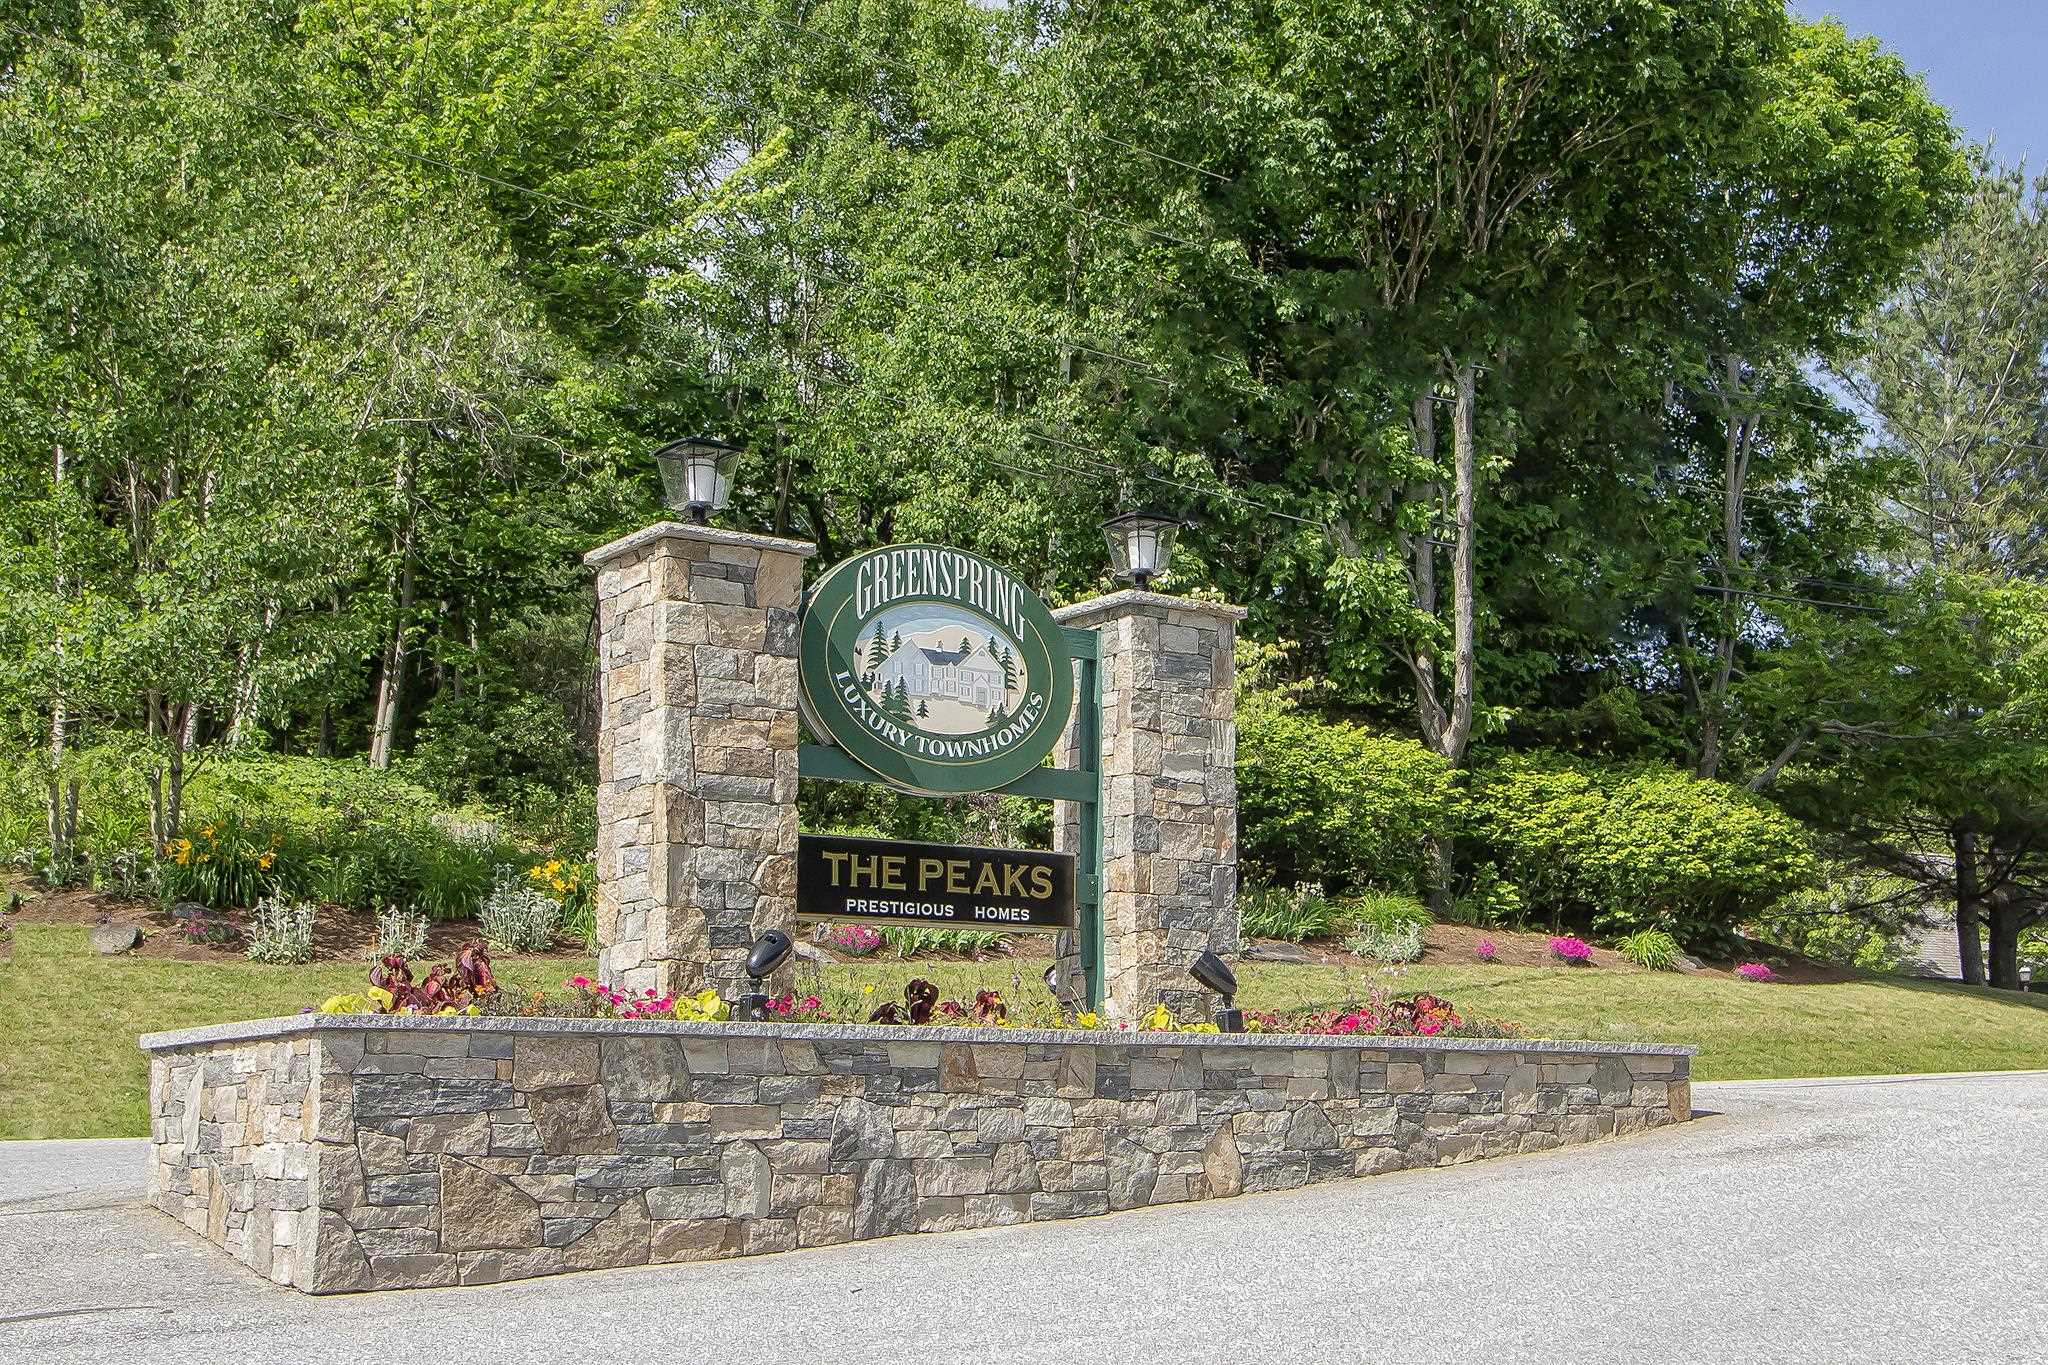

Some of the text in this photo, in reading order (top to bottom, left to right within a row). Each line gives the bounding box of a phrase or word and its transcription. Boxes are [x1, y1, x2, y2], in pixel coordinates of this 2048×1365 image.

[856, 549, 1025, 642] GREENSPRING
[835, 670, 1044, 758] LUXURY TOWNHOMES
[822, 850, 1053, 899] THE PEAKS
[846, 899, 1030, 921] PRESTIGIOUS HOMES
